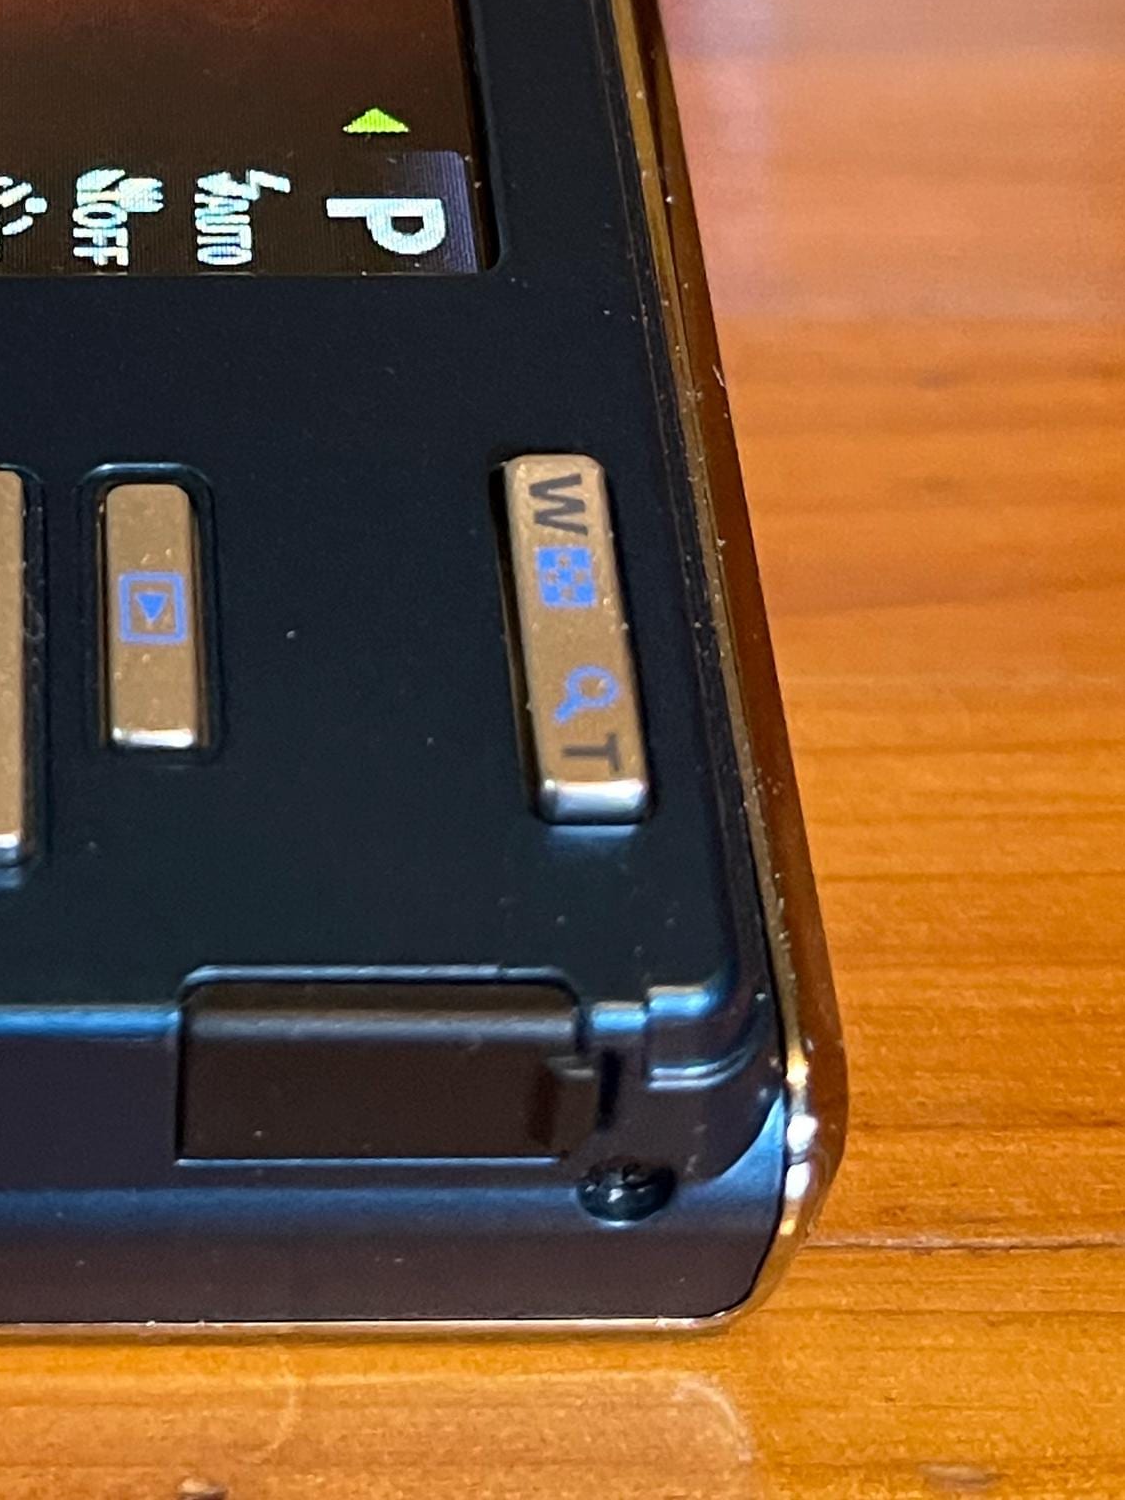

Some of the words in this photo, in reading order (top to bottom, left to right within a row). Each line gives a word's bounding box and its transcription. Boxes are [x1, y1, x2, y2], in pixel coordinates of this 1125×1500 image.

[72, 202, 130, 267] OFF
[194, 192, 253, 267] AUTO
[326, 197, 447, 255] P
[528, 473, 588, 536] W
[562, 732, 620, 772] T
